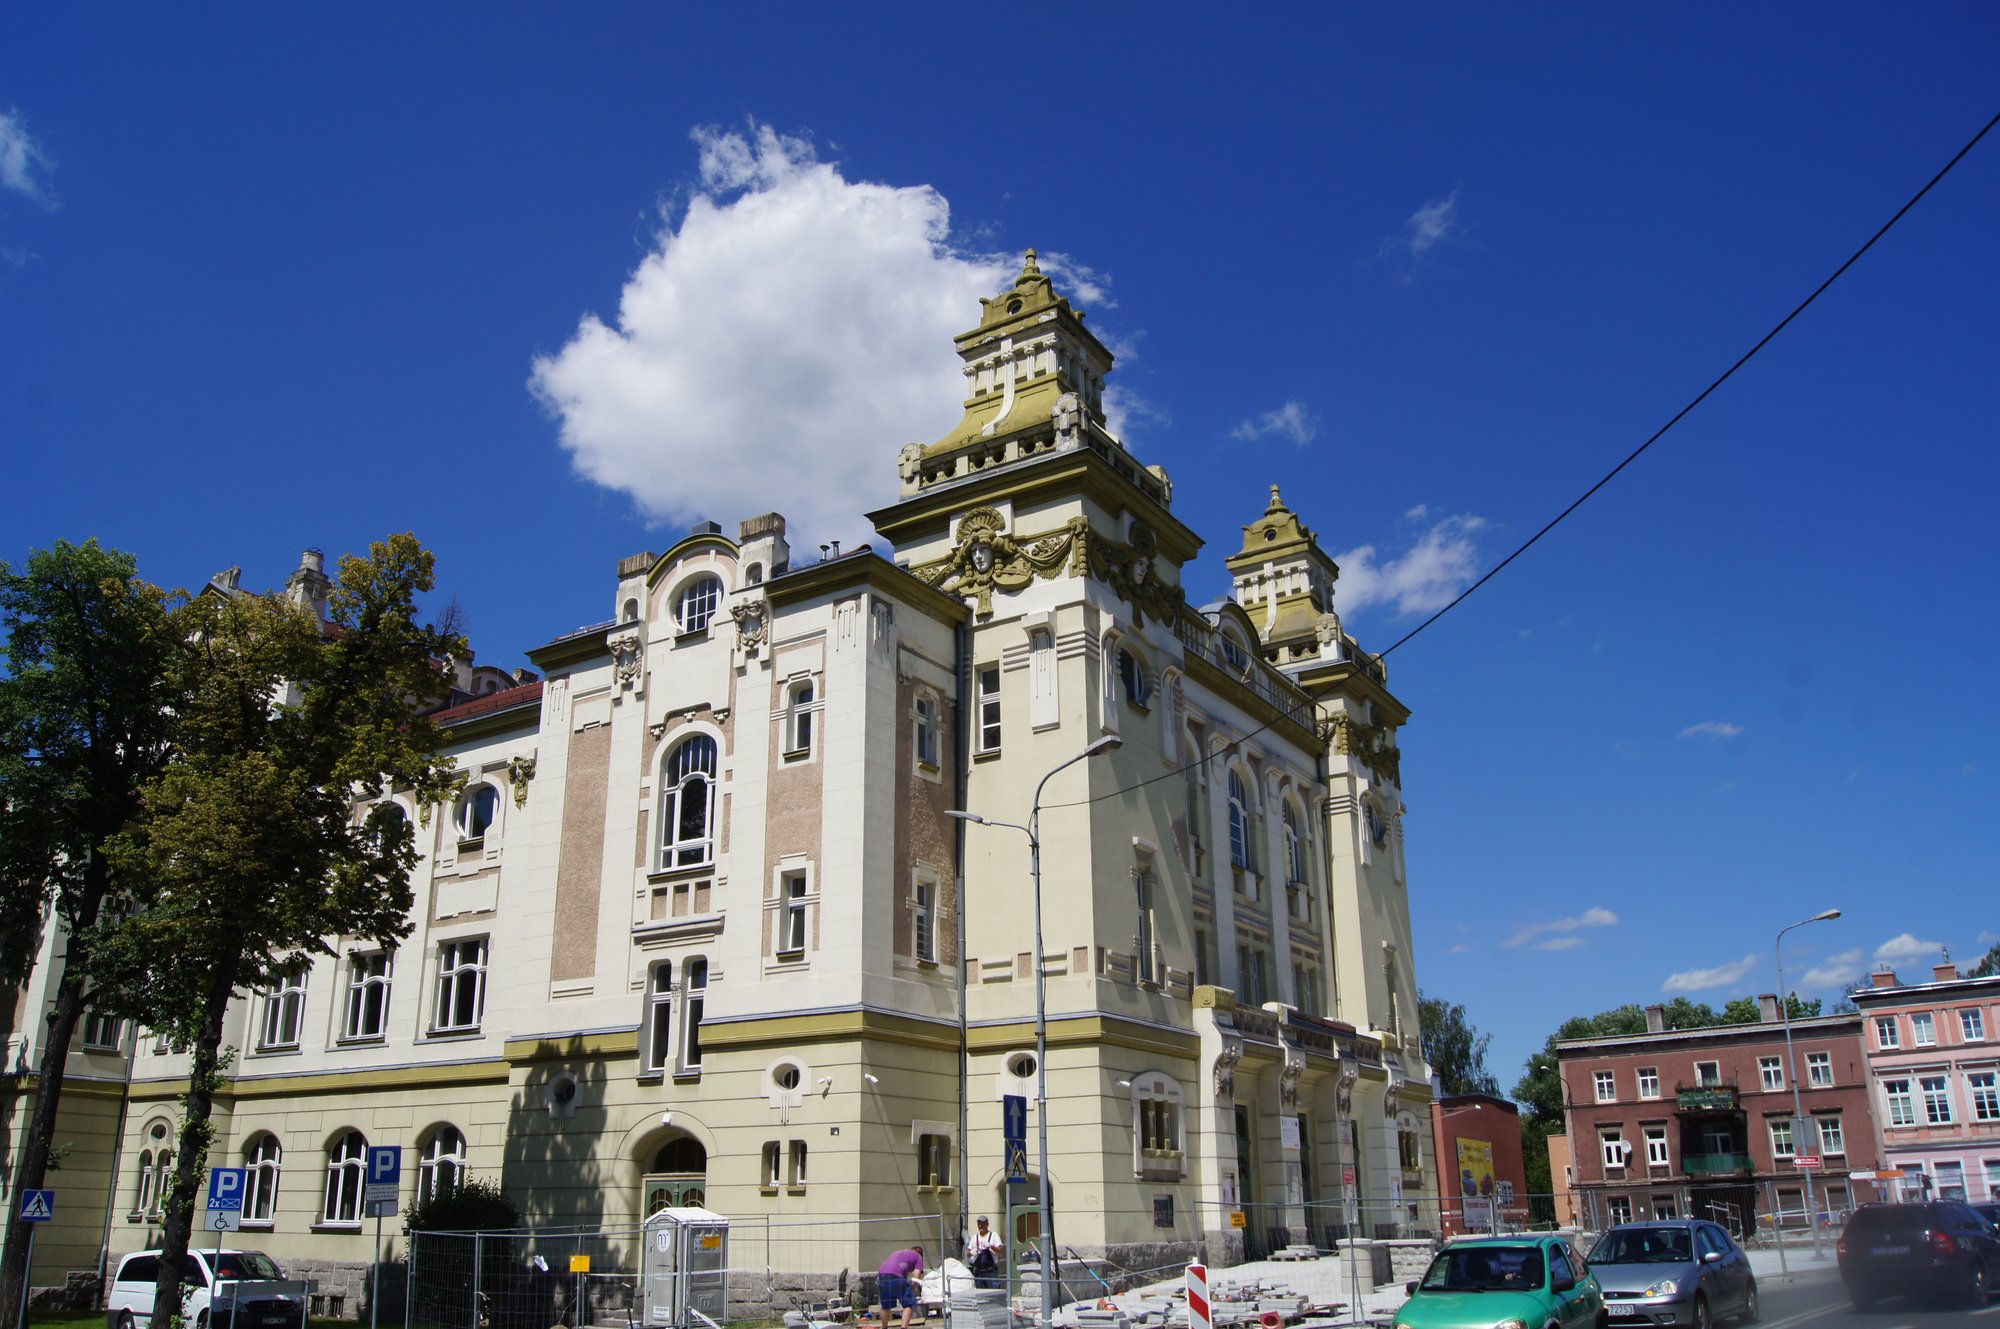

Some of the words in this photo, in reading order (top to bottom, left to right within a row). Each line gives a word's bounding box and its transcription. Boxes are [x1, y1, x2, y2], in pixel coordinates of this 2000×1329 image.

[375, 1151, 394, 1179] P
[217, 1172, 238, 1198] P
[209, 1198, 220, 1208] 2x
